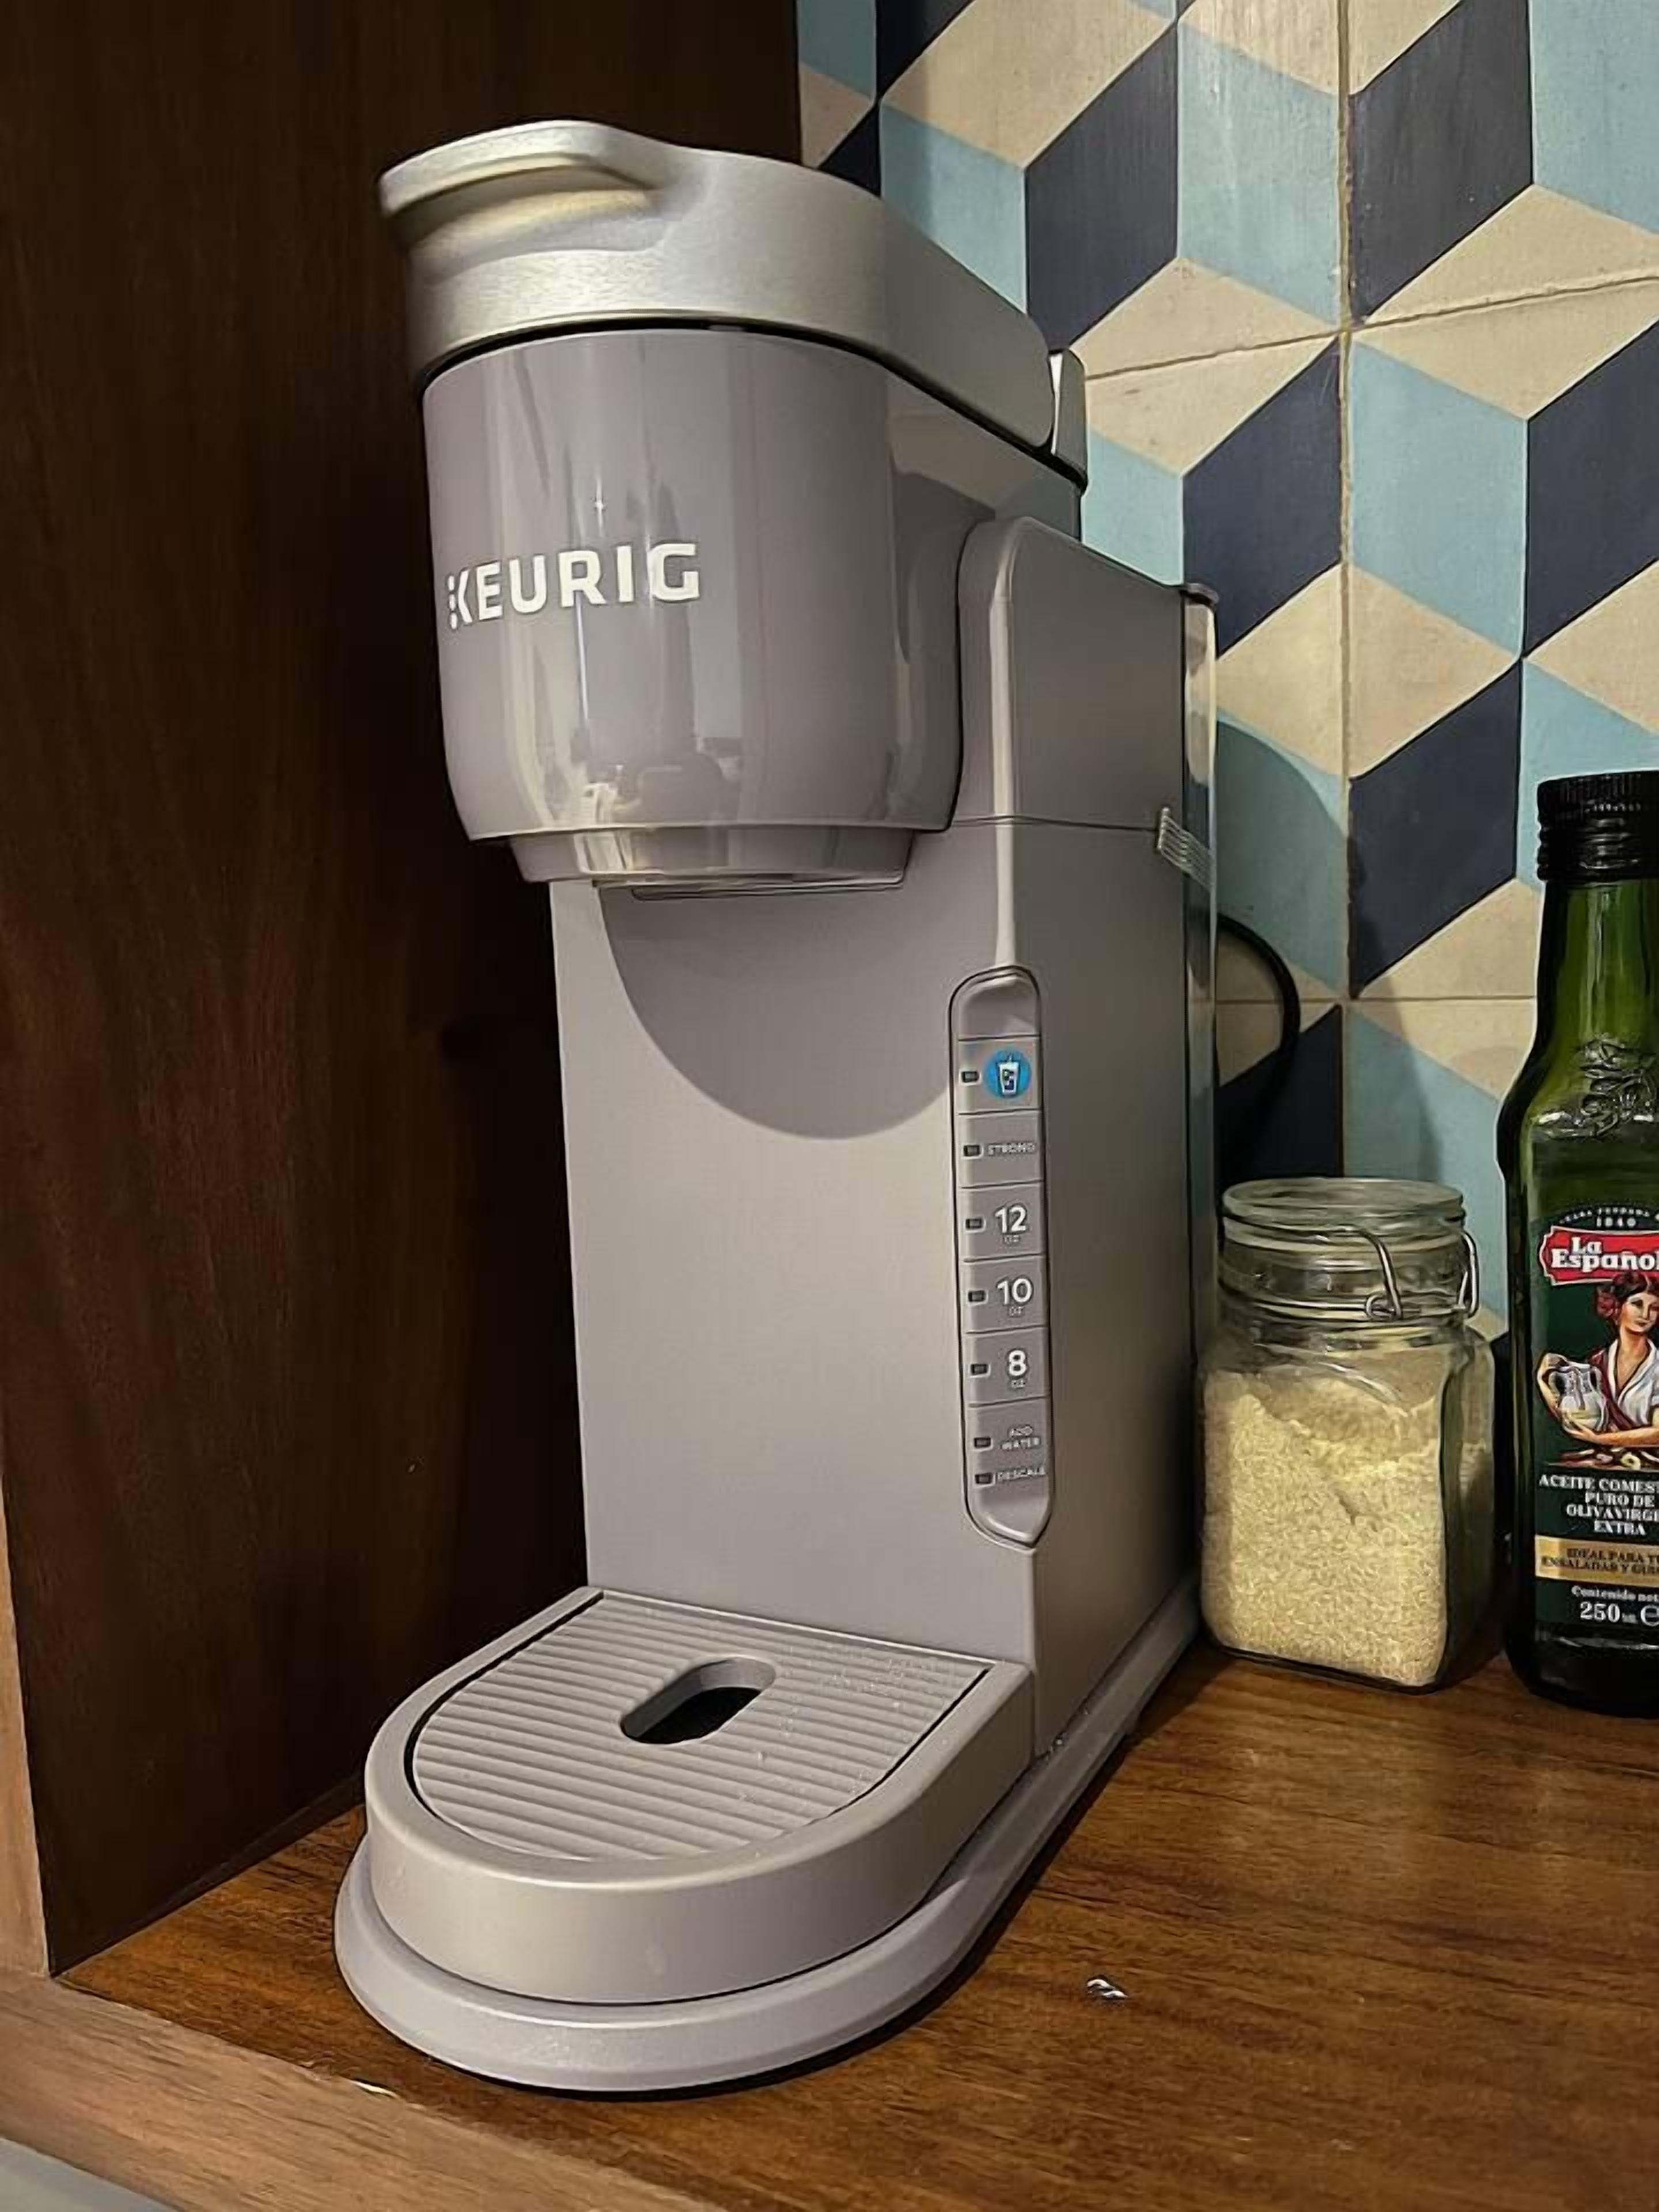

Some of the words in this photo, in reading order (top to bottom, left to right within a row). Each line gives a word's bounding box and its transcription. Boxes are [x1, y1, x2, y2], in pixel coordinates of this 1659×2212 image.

[448, 543, 700, 629] KEURIG
[995, 1206, 1027, 1233] 12
[1571, 1237, 1602, 1254] La
[997, 1278, 1032, 1305] 10
[1009, 1350, 1027, 1376] 8
[1539, 1475, 1596, 1490] ACEITE
[1585, 1491, 1630, 1506] PURO
[1634, 1495, 1655, 1508] DE
[1594, 1520, 1646, 1536] EXTRA
[1609, 1551, 1645, 1563] PARA
[1580, 1601, 1620, 1623] 250
